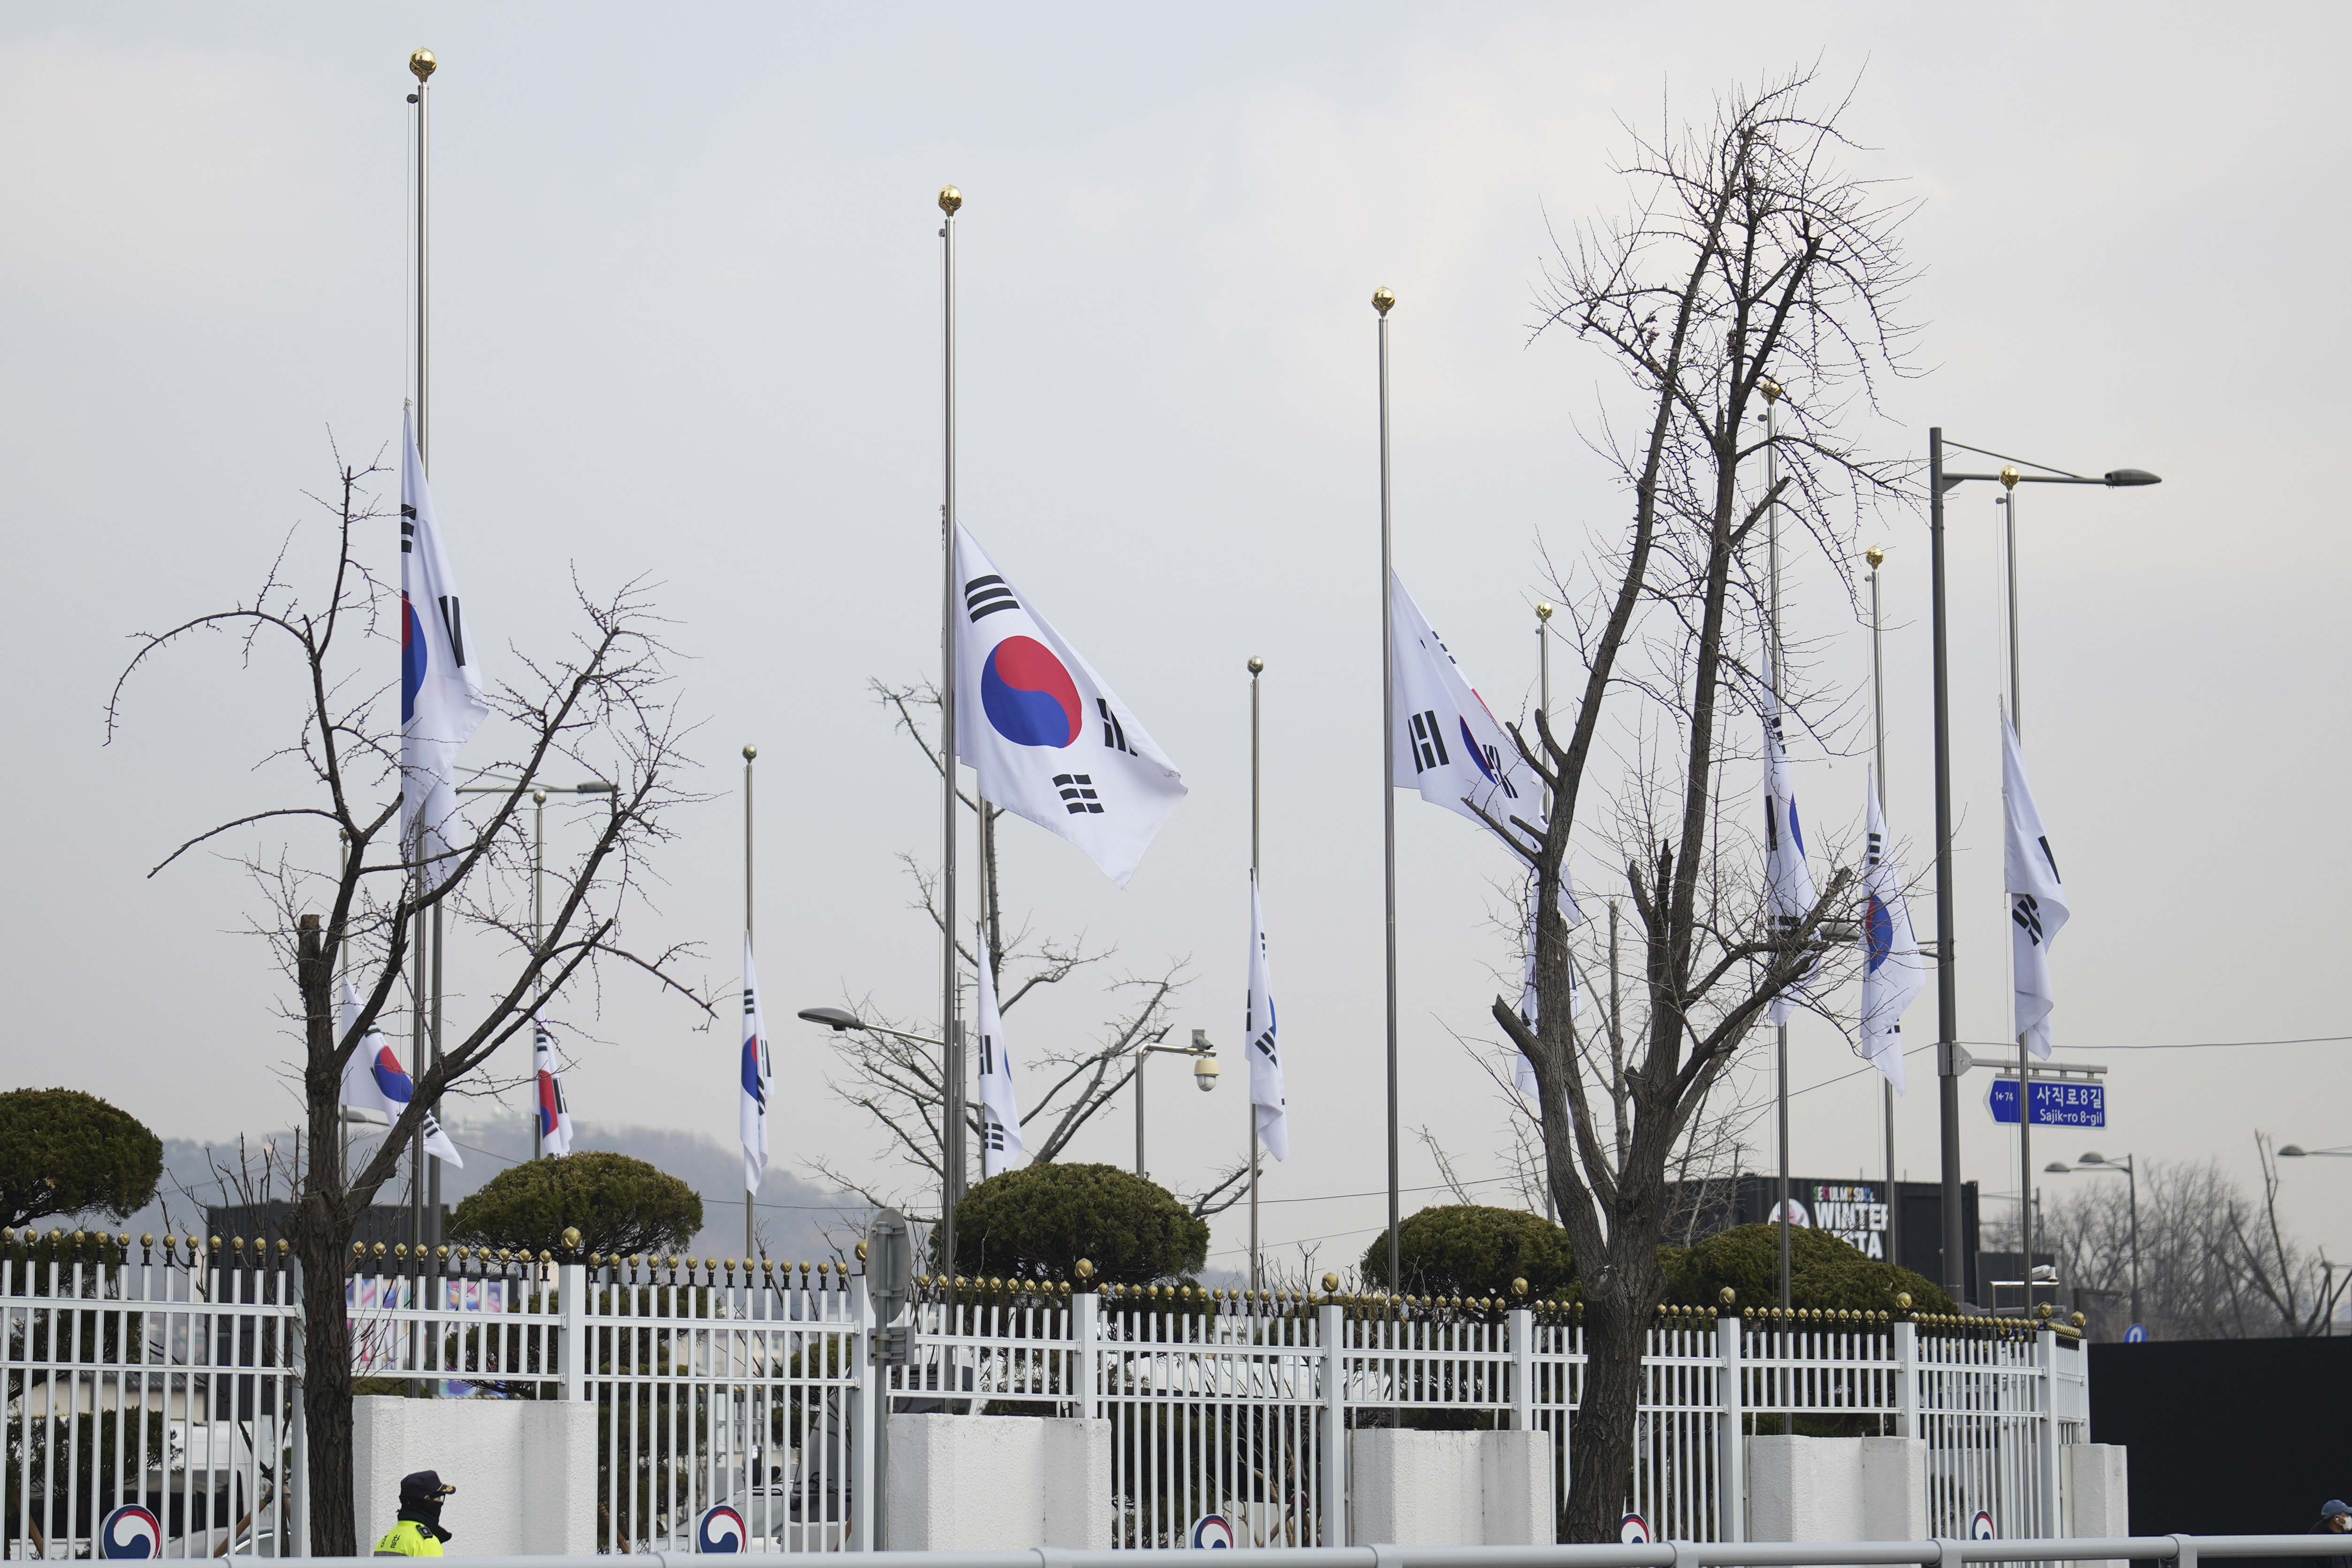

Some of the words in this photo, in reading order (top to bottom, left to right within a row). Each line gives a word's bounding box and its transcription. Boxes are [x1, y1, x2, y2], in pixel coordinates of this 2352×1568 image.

[2004, 1092, 2014, 1102] 74
[2037, 1085, 2101, 1109] 사직로8길
[2039, 1108, 2078, 1124] Sajik-ro
[2080, 1111, 2102, 1126] 8-gil
